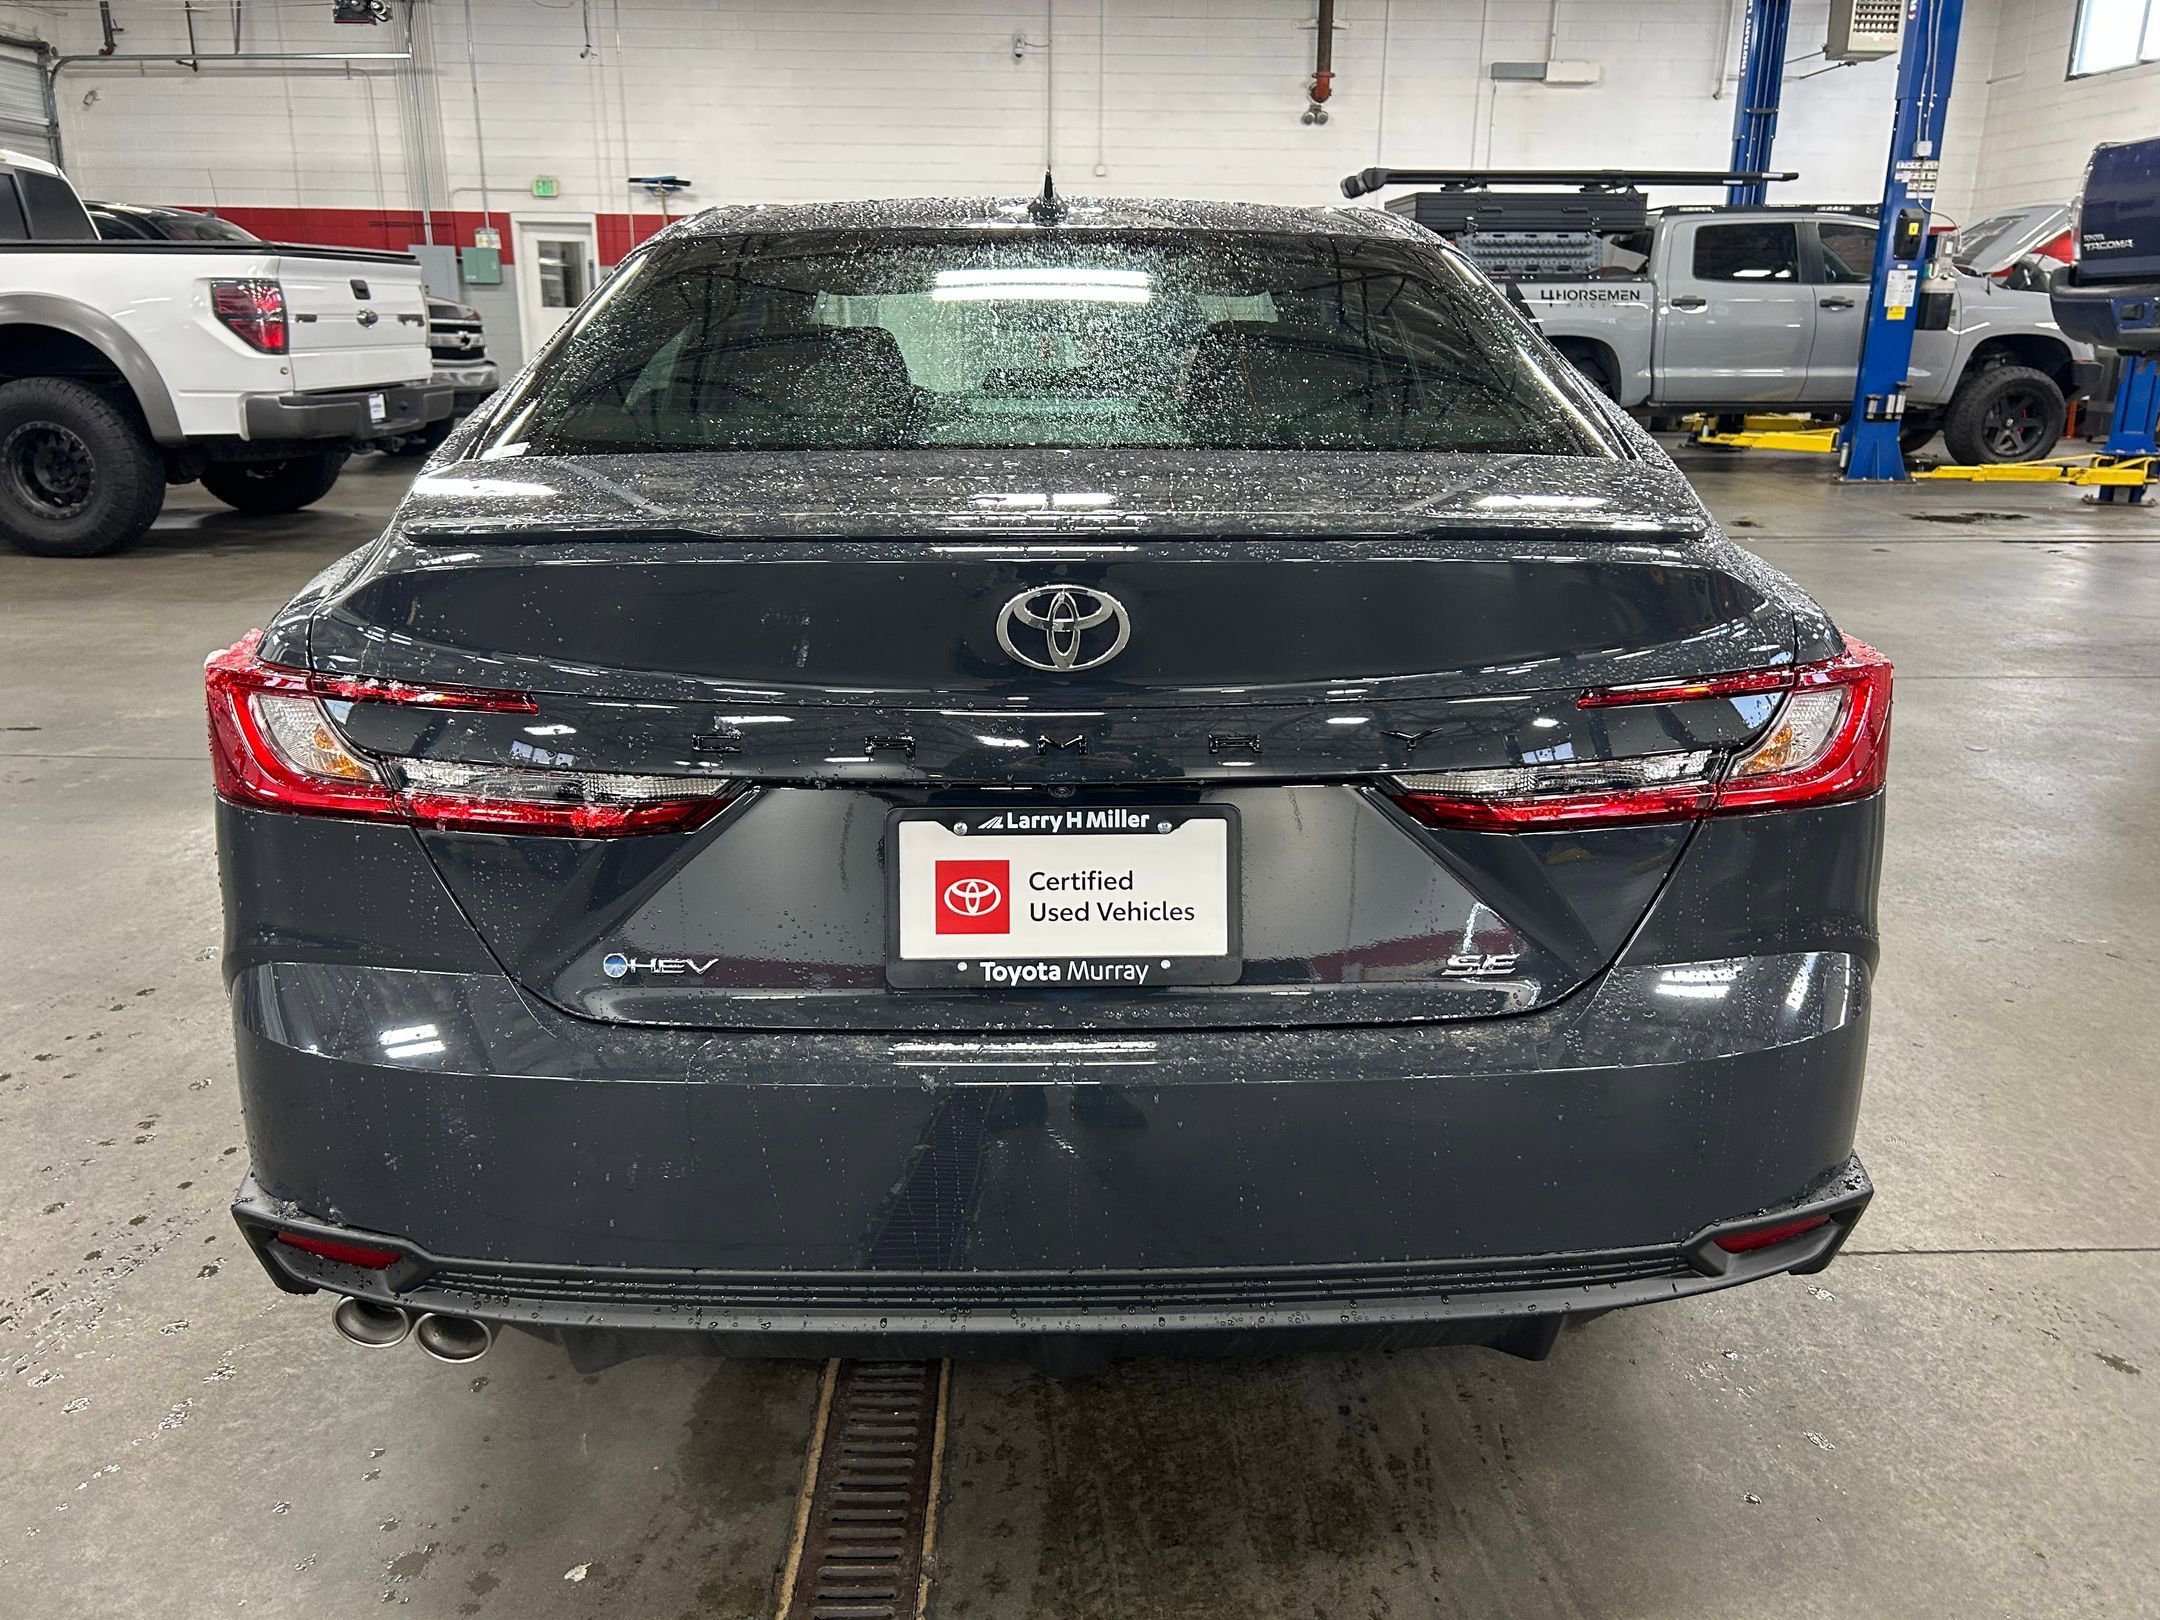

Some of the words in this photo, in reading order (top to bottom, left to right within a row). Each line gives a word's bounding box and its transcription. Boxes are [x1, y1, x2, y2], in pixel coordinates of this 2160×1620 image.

[2083, 239, 2134, 251] TACOMA
[1007, 811, 1063, 833] Larry
[1067, 812, 1082, 829] H
[1086, 809, 1150, 829] Miller
[1028, 870, 1134, 891] Certified
[1029, 902, 1089, 922] Used
[1097, 901, 1195, 922] Vehicles
[630, 957, 719, 974] HEV
[980, 961, 1061, 986] Toyota
[1067, 960, 1149, 985] Murray
